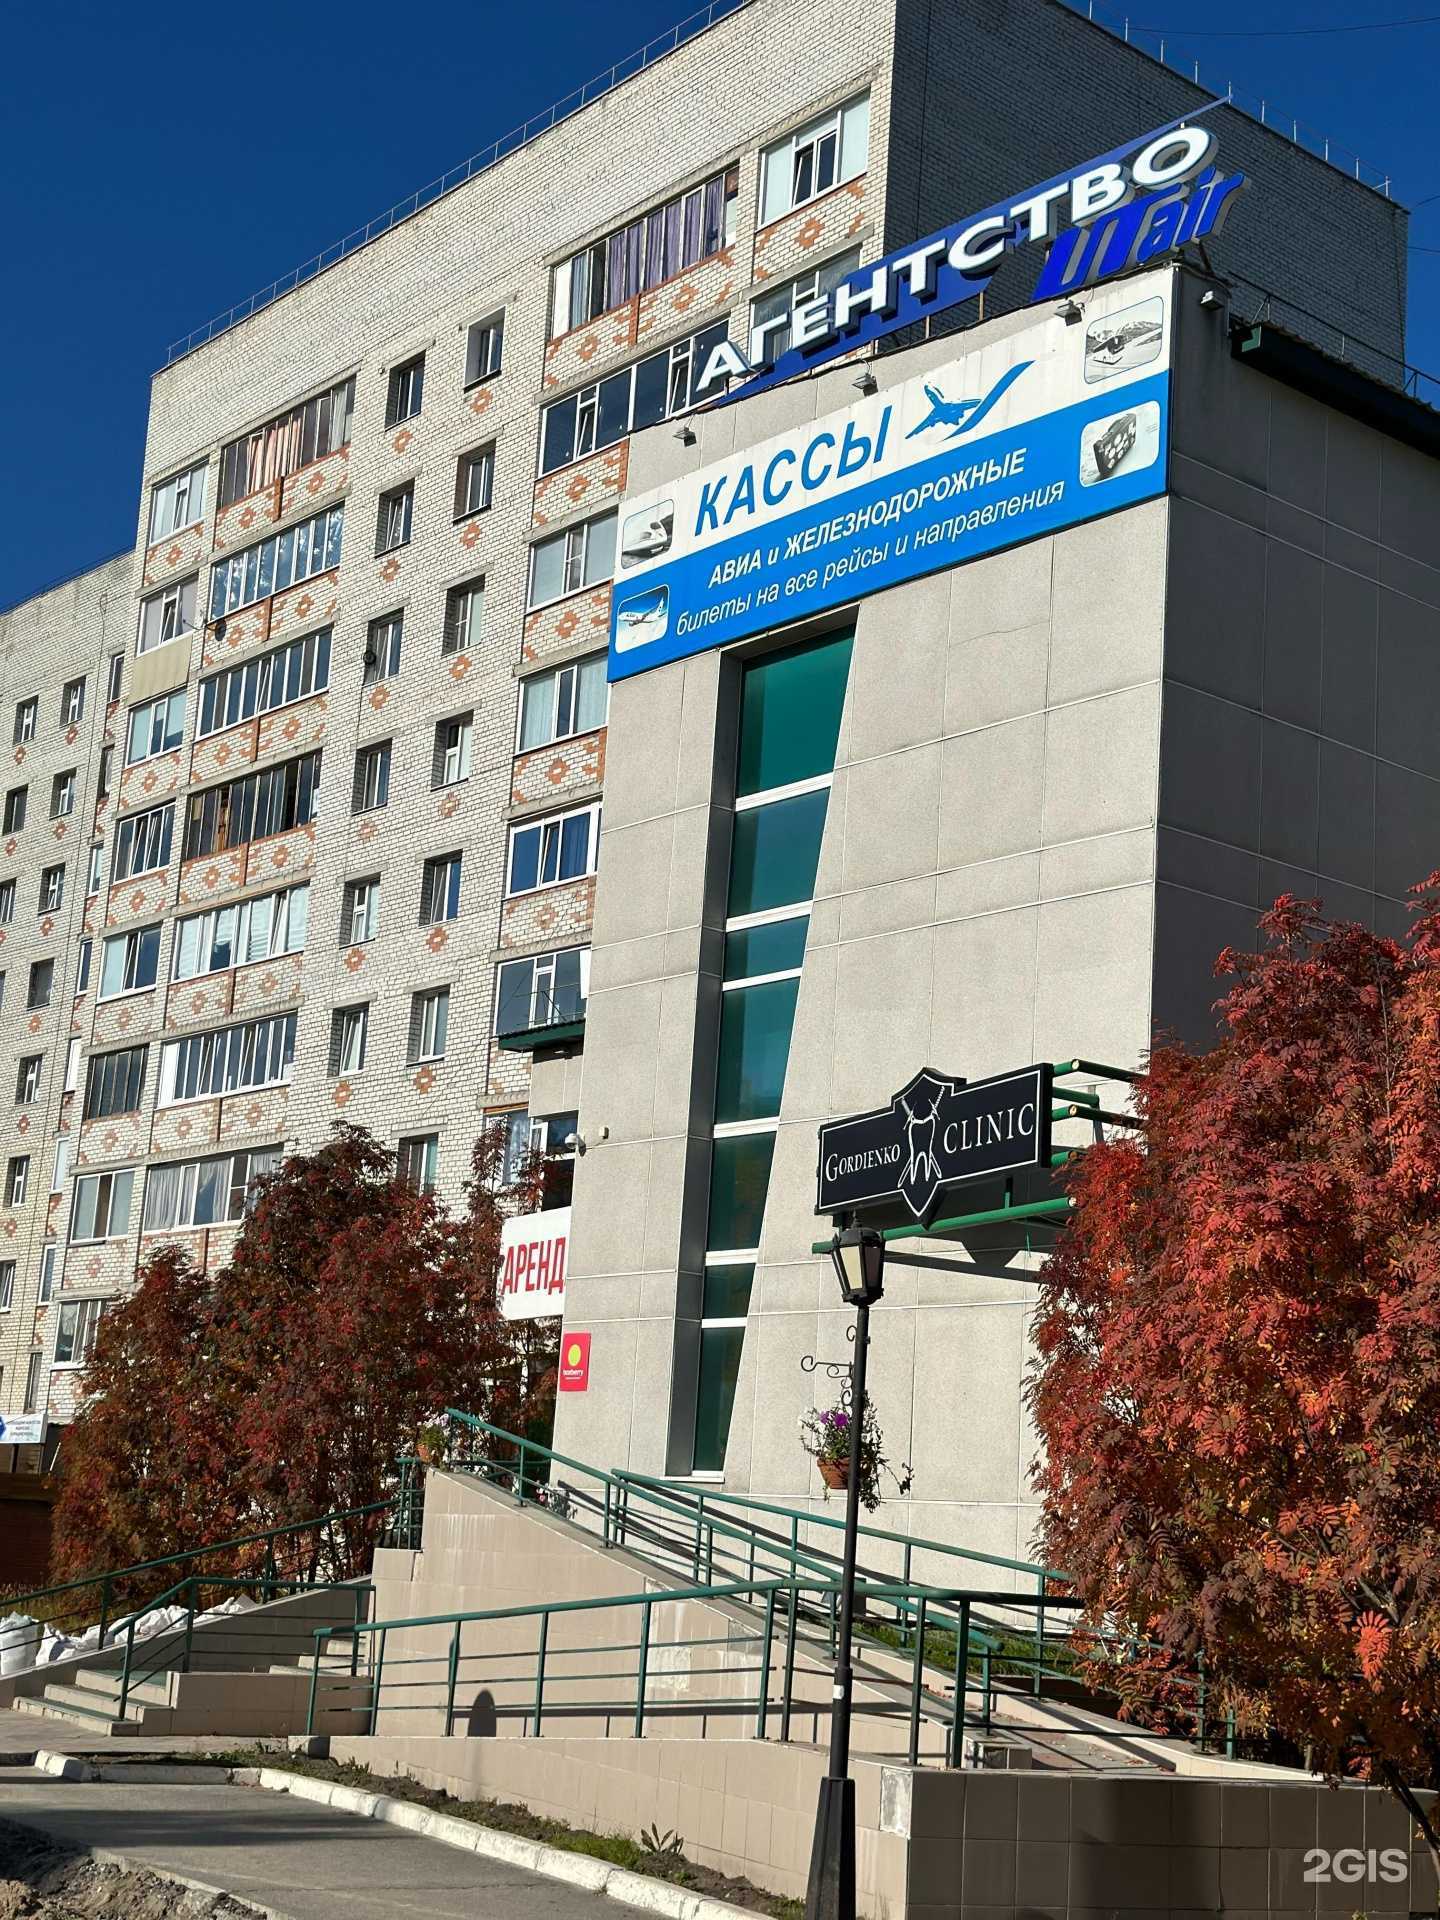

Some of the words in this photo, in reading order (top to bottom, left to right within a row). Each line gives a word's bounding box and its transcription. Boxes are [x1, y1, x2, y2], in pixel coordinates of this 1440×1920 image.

[696, 127, 1214, 393] АГЕНТСТВО
[694, 405, 893, 537] КАССЫ
[708, 549, 762, 589] АВИА
[768, 547, 780, 566] и
[783, 447, 1026, 560] ЖЕЛЕЗНОДОРОЖНЫЕ
[676, 593, 751, 636] билеты
[756, 583, 780, 608] на
[785, 569, 818, 595] все
[822, 541, 890, 588] рейсы
[895, 536, 908, 557] и
[914, 480, 1065, 551] направления
[943, 1103, 1034, 1153] CLINIC
[501, 1237, 566, 1296] АРЕНД
